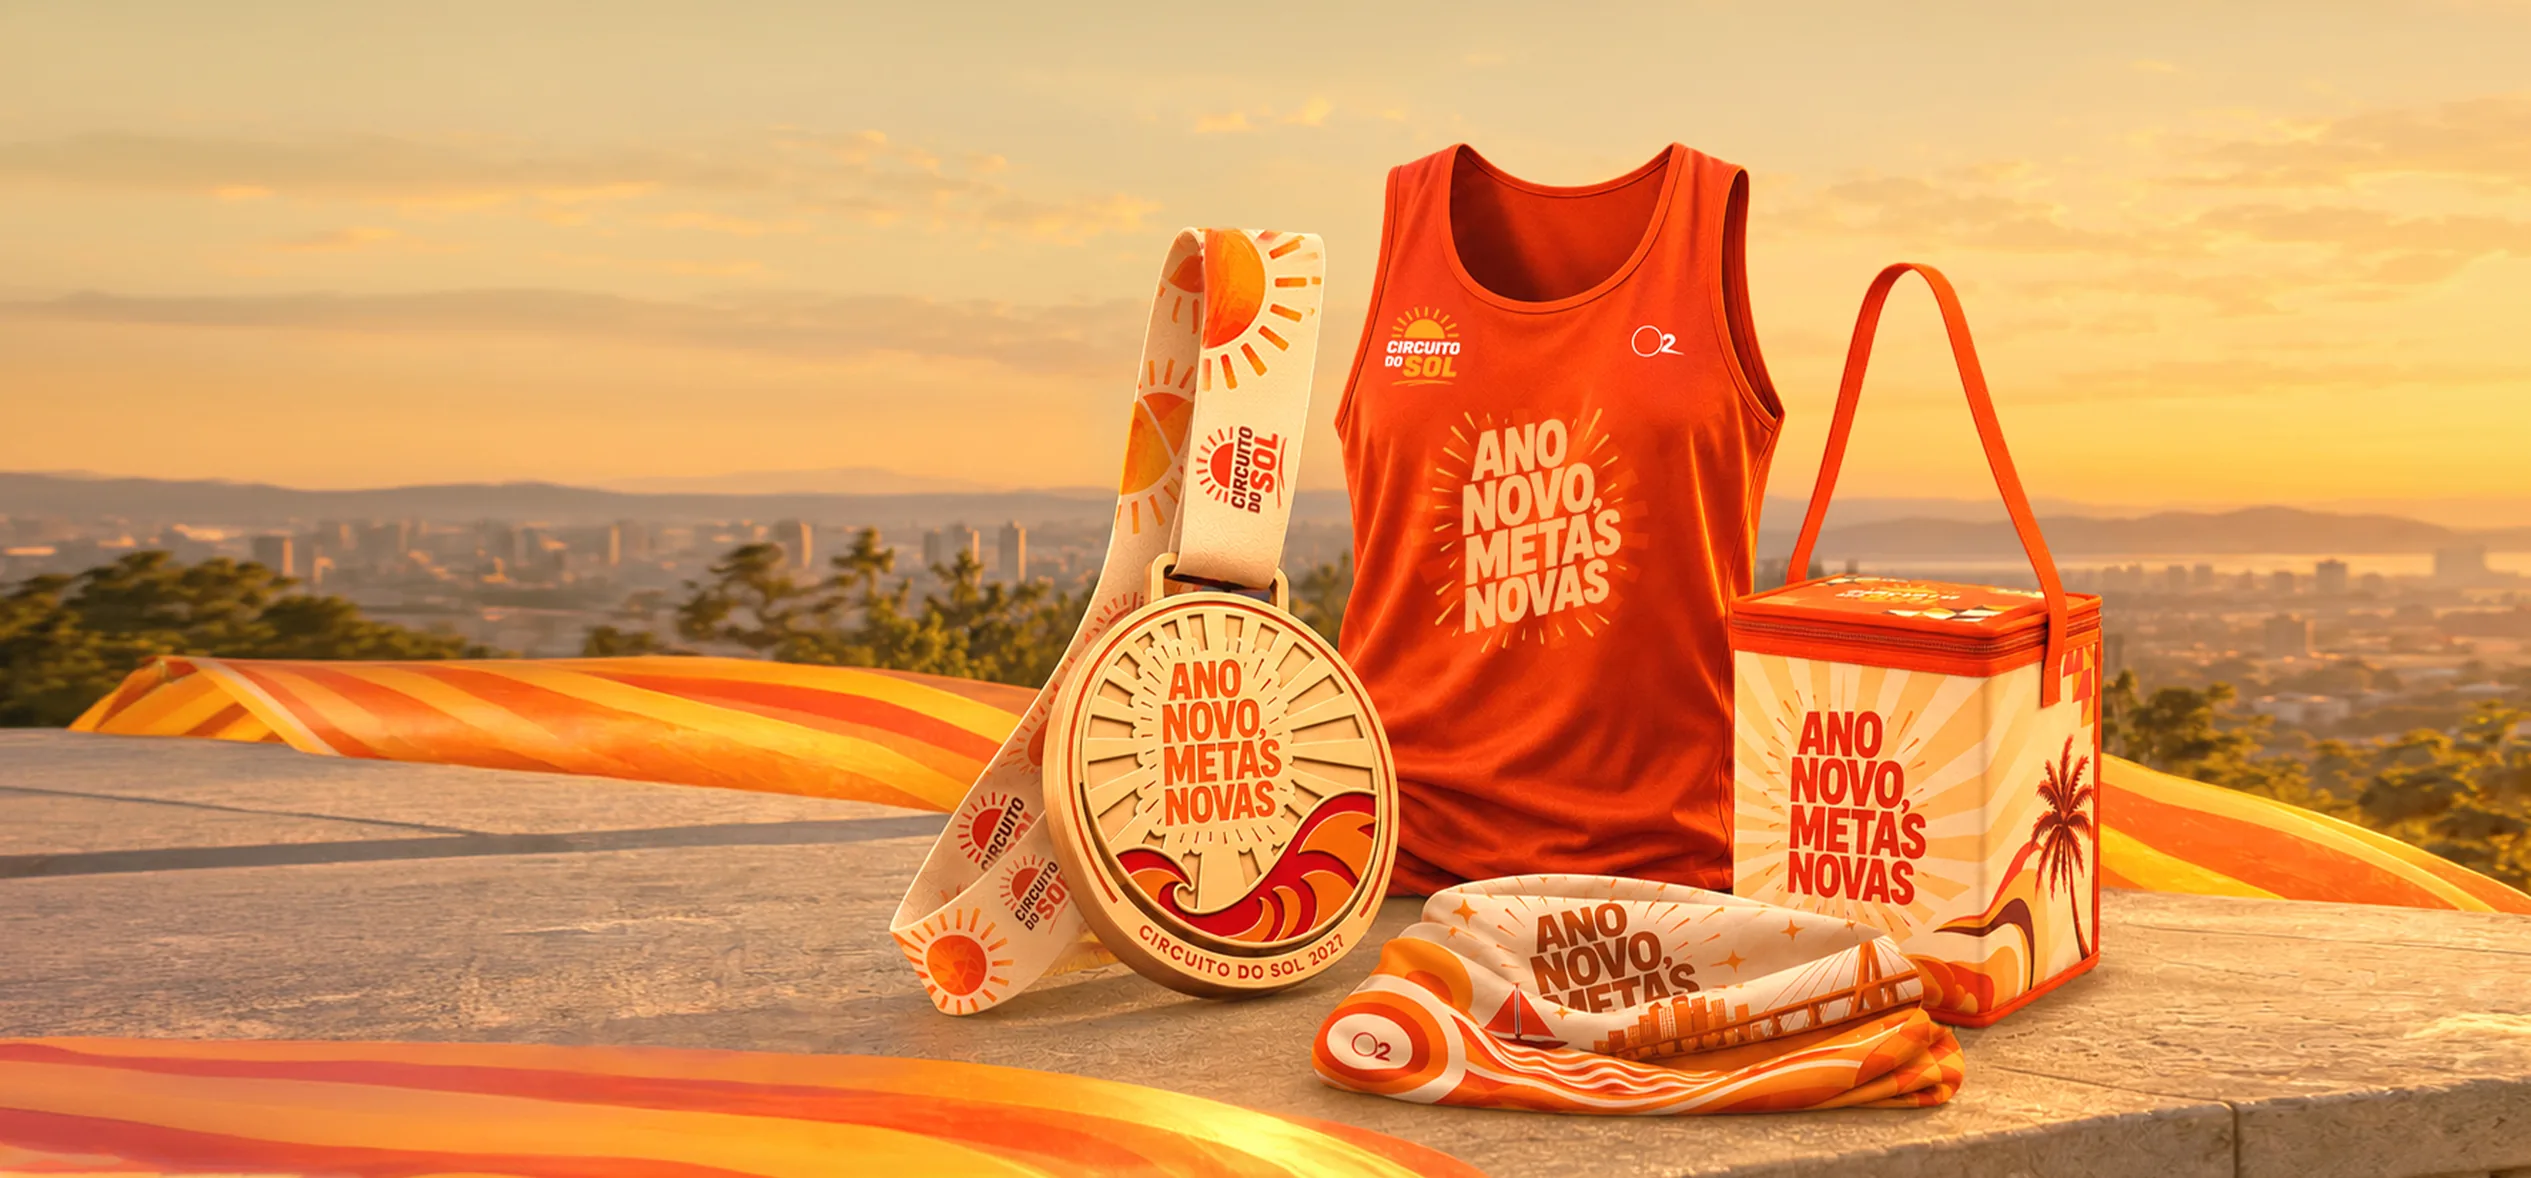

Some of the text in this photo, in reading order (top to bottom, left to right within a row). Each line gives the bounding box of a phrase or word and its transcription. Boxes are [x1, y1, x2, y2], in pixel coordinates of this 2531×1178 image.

[1384, 355, 1457, 378] DO SOL
[1386, 340, 1461, 355] CIRCUITO
[1631, 325, 1685, 357] O2
[1231, 426, 1253, 509] CIRCUITO
[1247, 433, 1278, 514] DO SOL
[1471, 419, 1567, 481] ANO
[1462, 462, 1603, 536] NOVO,
[1465, 508, 1622, 586] METAS
[1464, 559, 1610, 633] NOVAS
[1168, 659, 1241, 700] ANO
[1162, 698, 1266, 744] NOVO,
[1797, 711, 1883, 759] ANO
[1163, 739, 1281, 786] METAS
[1790, 756, 1910, 814] NOVO,
[1165, 780, 1276, 827] NOVAS
[1789, 804, 1926, 860] METAS
[1015, 861, 1058, 921] CIRCUITO
[1788, 851, 1915, 905] NOVAS
[1025, 912, 1039, 931] DO
[1537, 903, 1627, 954] ANO
[1139, 925, 1344, 980] CIRCUITO DO SOL 2027
[1530, 931, 1672, 996] NOVO,
[1351, 1031, 1391, 1062] O2
